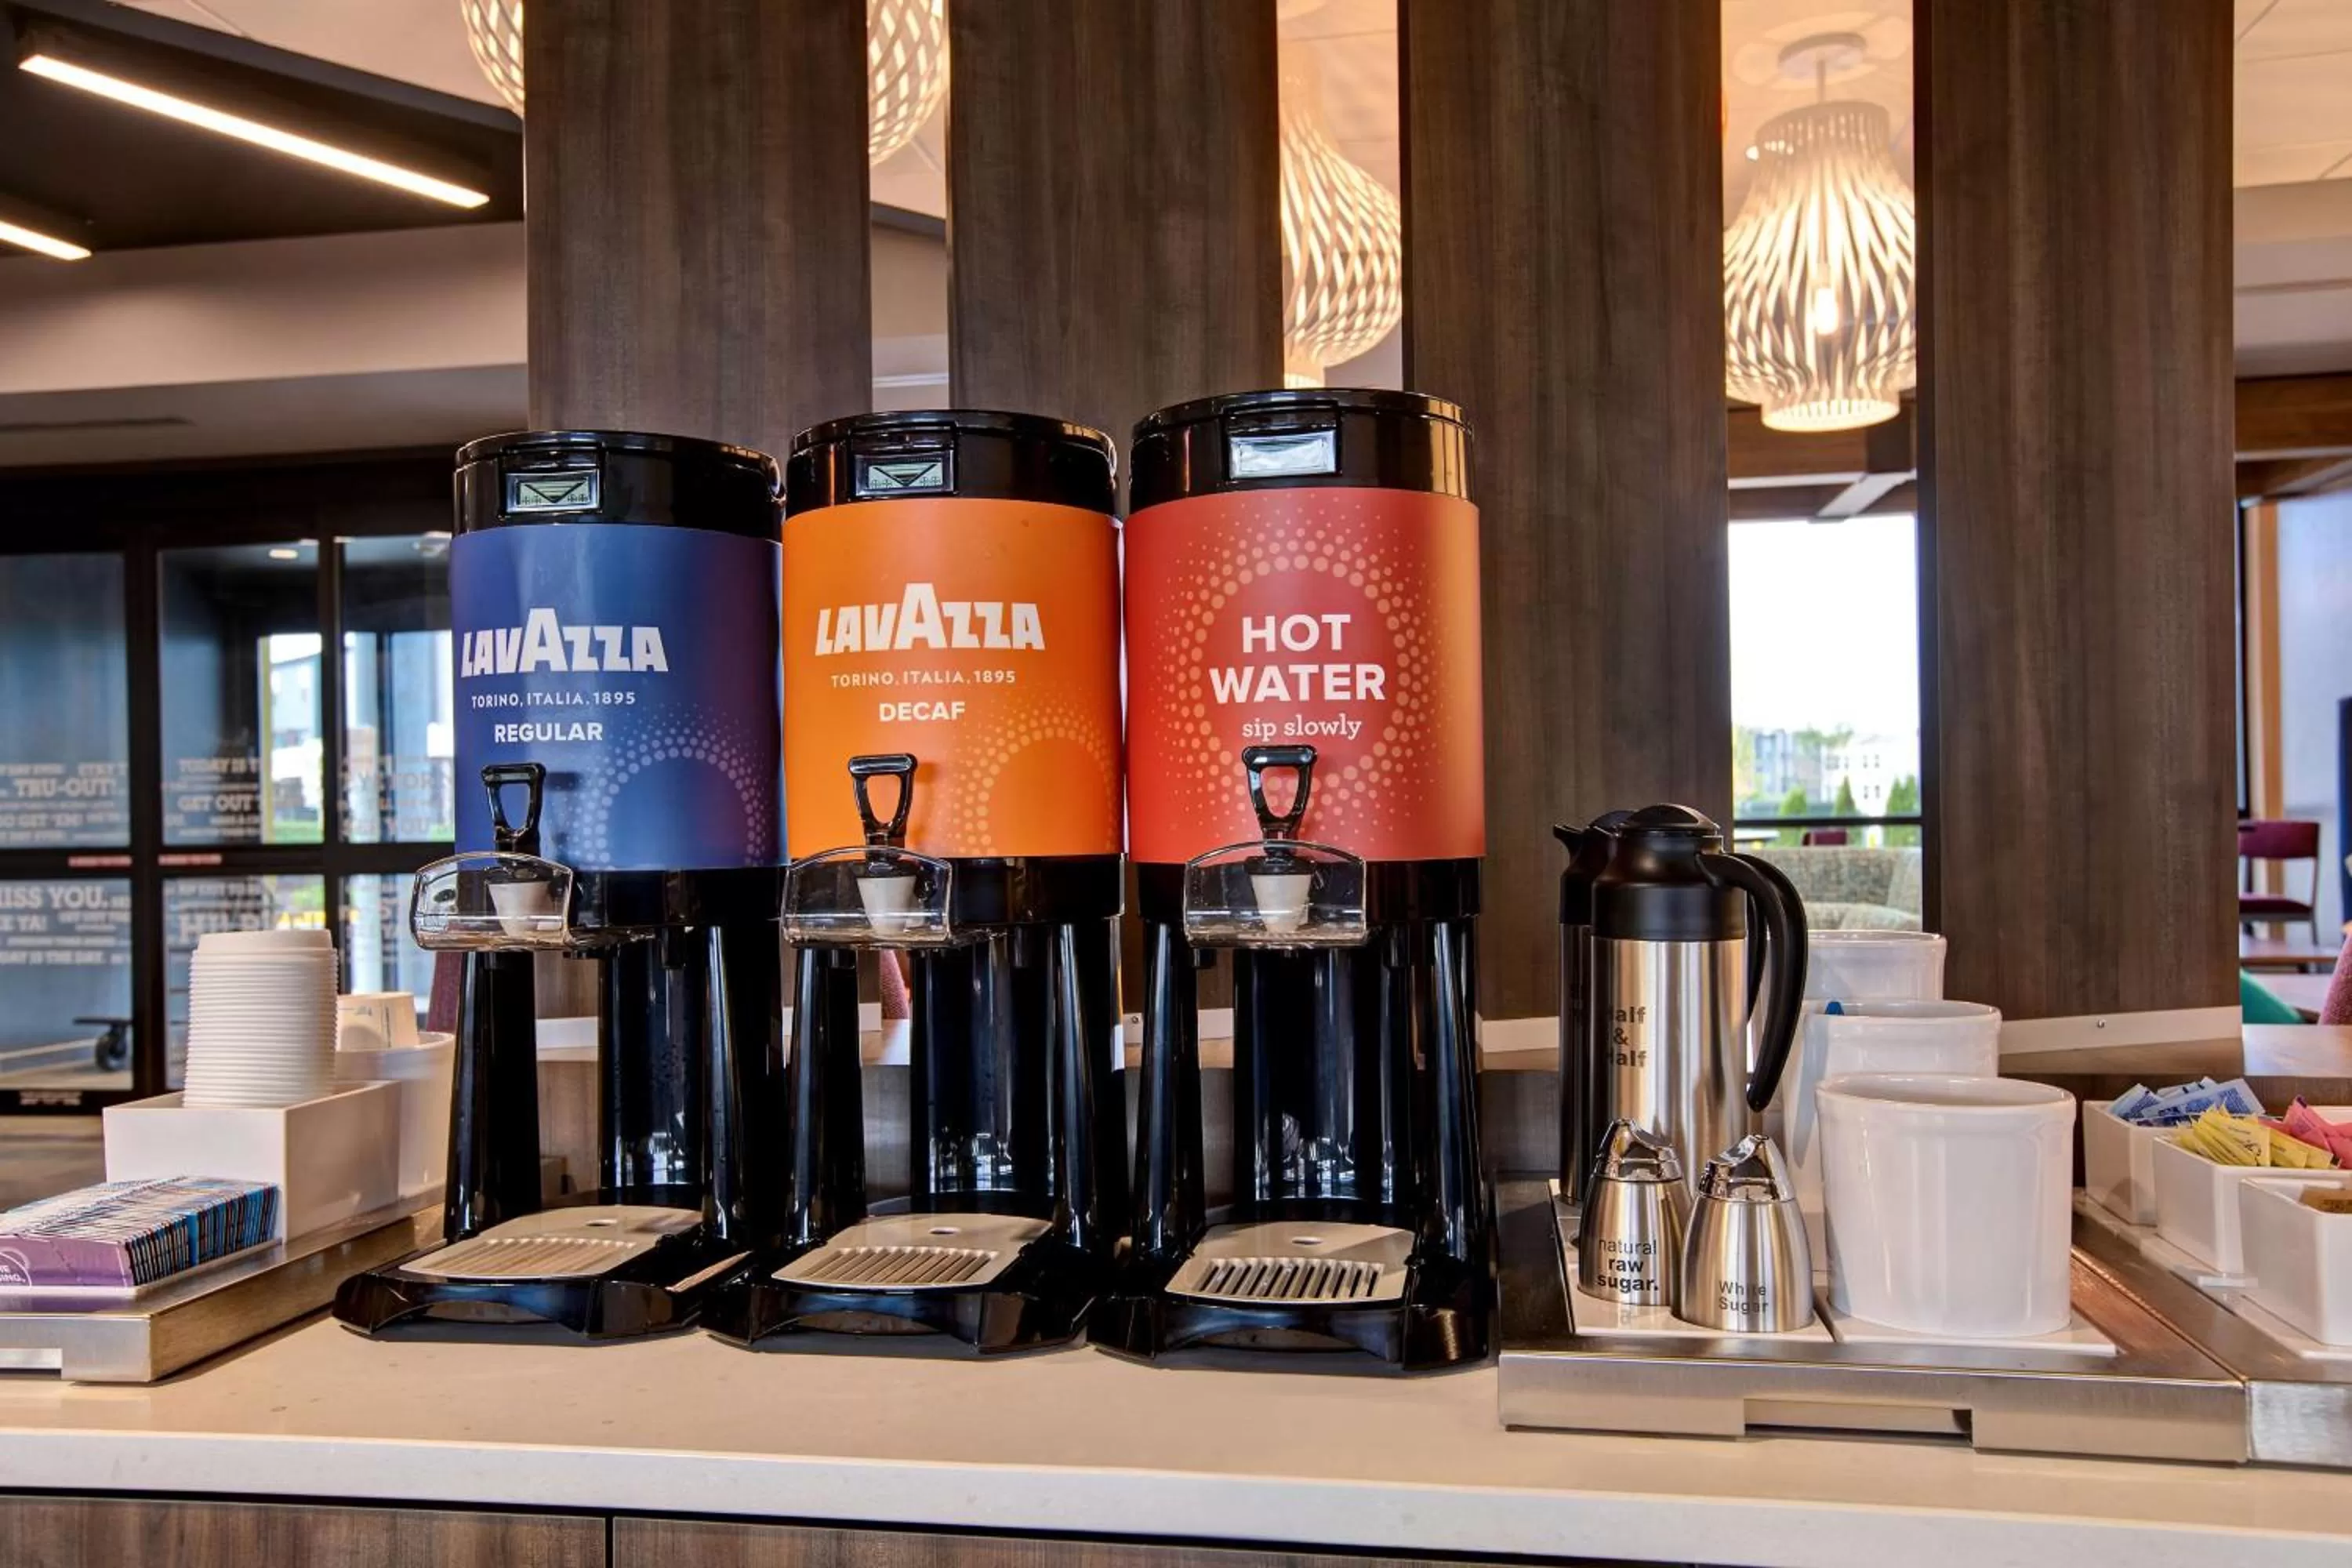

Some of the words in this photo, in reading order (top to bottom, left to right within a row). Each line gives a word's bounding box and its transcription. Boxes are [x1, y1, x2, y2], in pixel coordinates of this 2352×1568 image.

[815, 583, 1045, 655] LAVAZZA
[460, 608, 669, 677] LAVAZZA
[1242, 614, 1351, 653] HOT
[974, 670, 1016, 684] 1895
[1209, 664, 1386, 703] WATER
[593, 691, 636, 705] 1895
[879, 701, 966, 722] DECAF
[494, 722, 604, 743] REGULAR
[1242, 717, 1277, 742] sip
[1283, 713, 1362, 740] slowly
[1613, 1028, 1628, 1045] &
[1599, 1240, 1657, 1255] natural
[1609, 1258, 1643, 1272] raw
[1597, 1275, 1658, 1294] sugar.
